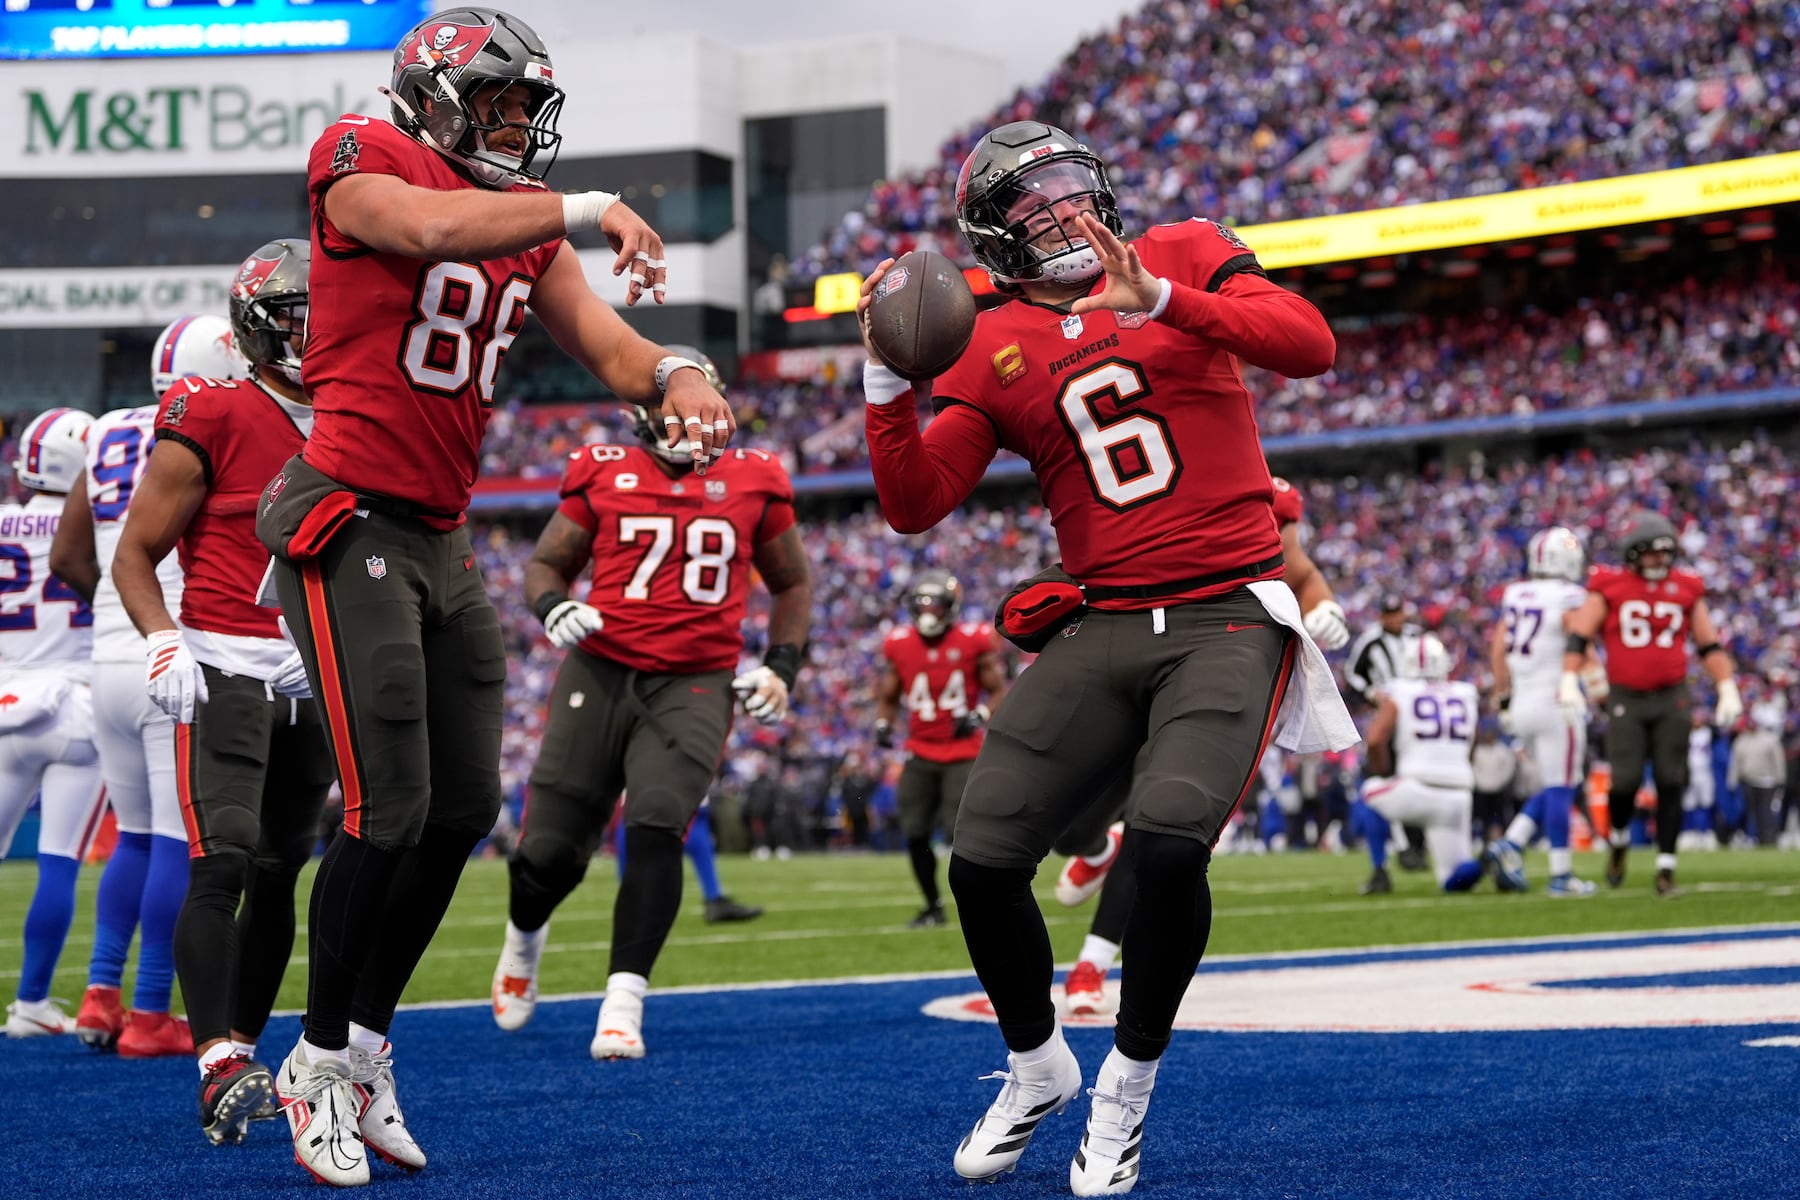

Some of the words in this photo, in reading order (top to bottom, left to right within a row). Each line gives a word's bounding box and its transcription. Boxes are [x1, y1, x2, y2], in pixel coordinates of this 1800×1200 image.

[22, 88, 200, 155] M&T
[994, 345, 1021, 377] C
[1048, 333, 1120, 376] BUCCANEERS
[1056, 358, 1183, 513] 6
[93, 426, 157, 521] 9
[615, 473, 638, 488] C
[705, 481, 725, 493] 50
[1, 515, 60, 536] BISHO
[618, 515, 737, 605] 78
[1620, 600, 1683, 648] 67
[907, 669, 968, 722] 44
[1414, 696, 1467, 739] 92
